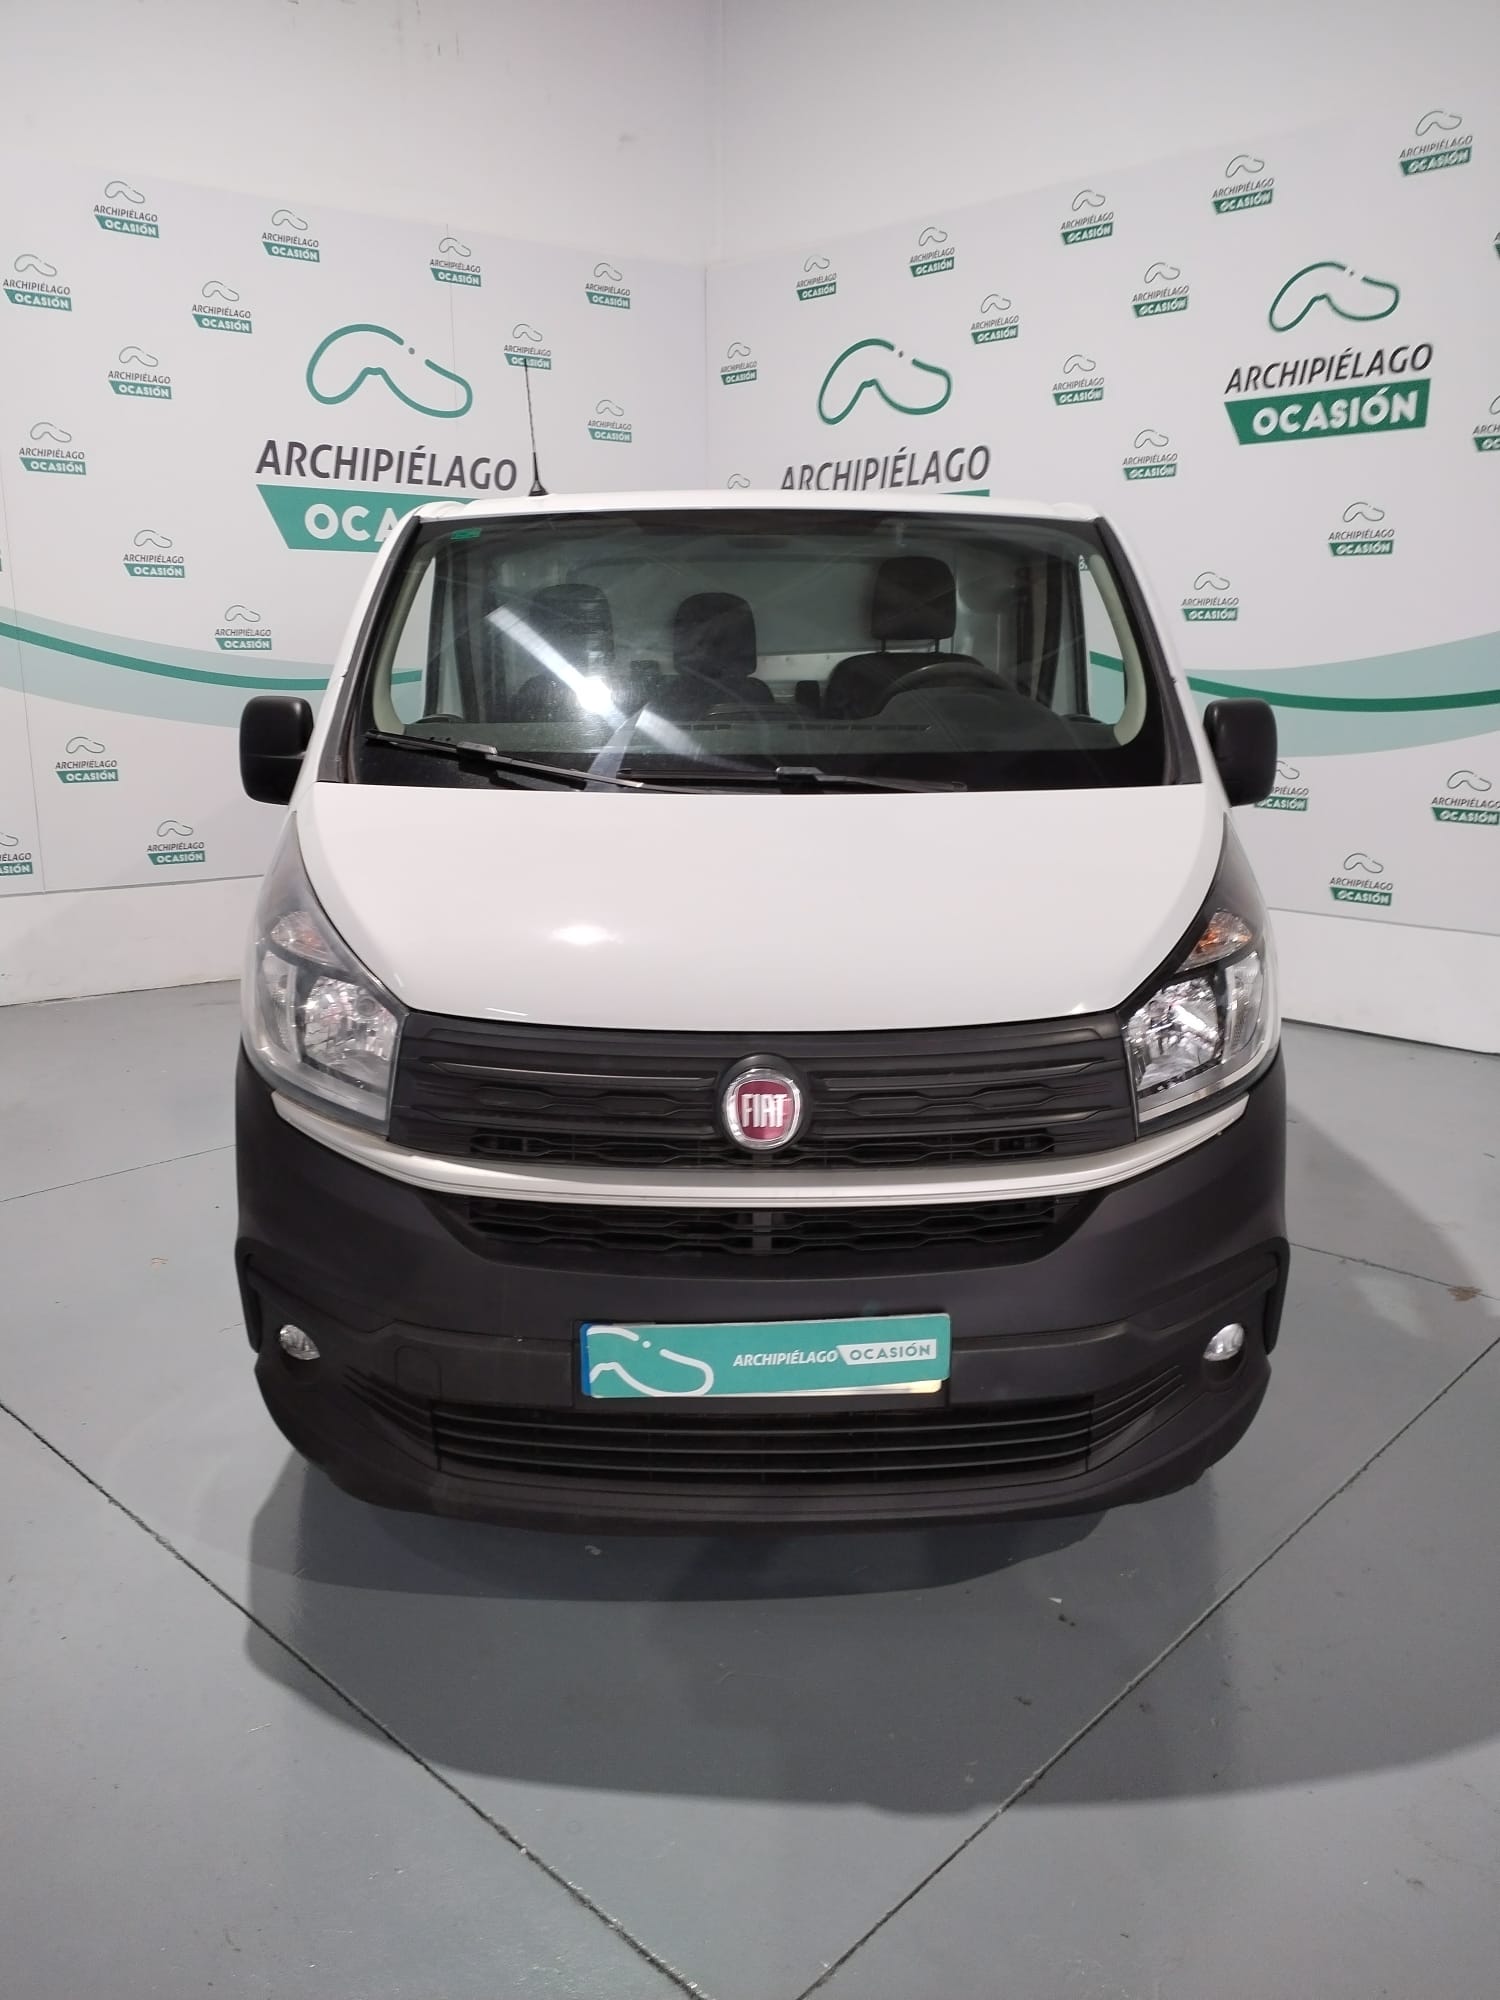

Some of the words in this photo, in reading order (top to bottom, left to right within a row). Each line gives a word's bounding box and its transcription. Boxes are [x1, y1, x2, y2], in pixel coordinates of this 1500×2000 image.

[1399, 135, 1473, 159] ARCHIPIÉLAGO
[1212, 178, 1275, 198] ARCHIPIÉLAGO
[93, 204, 158, 223] ARCHIPIÉLAGO
[1061, 211, 1114, 230] ARCHIPIÉLAGO
[262, 232, 319, 248] ARCHIPIÉLAGO
[909, 247, 955, 263] ARCHIPIÉLAGO
[430, 259, 481, 273] ARCHIPIÉLAGO
[2, 278, 71, 296] ARCHIPIÉLAGO
[796, 273, 837, 288] ARCHIPIÉLAGO
[585, 283, 631, 297] ARCHIPIÉLAGO
[1132, 285, 1189, 302] ARCHIPIÉLAGO
[191, 304, 252, 319] ARCHIPIÉLAGO
[970, 315, 1019, 331] ARCHIPIÉLAGO
[504, 344, 552, 357] ARCHIPIÉLAGO
[1224, 343, 1433, 394] ARCHIPIÉLAGO
[108, 370, 171, 384] ARCHIPIÉLAGO
[1052, 377, 1105, 391] ARCHIPIÉLAGO
[1252, 387, 1418, 436] OCASIÓN
[587, 419, 632, 431] ARCHIPIÉLAGO
[18, 447, 85, 460] ARCHIPIÉLAGO
[1122, 453, 1178, 465] ARCHIPIÉLAGO
[256, 439, 517, 491] ARCHIPIÉLAGO
[781, 446, 989, 490] ARCHIPIÉLAGO
[1328, 528, 1395, 541] ARCHIPIÉLAGO
[123, 554, 184, 565] ARCHIPIÉLAGO
[1181, 597, 1240, 607] ARCHIPIÉLAGO
[214, 628, 272, 637] ARCHIPIÉLAGO
[55, 760, 118, 770] ARCHIPIÉLAGO
[147, 841, 205, 852] ARCHIPIÉLAGO
[1329, 877, 1393, 891] ARCHIPIÉLAGO
[741, 1093, 787, 1128] FIAT
[733, 1349, 839, 1367] ARCHIPIÉLAGO
[849, 1342, 931, 1362] OCASIÓN
